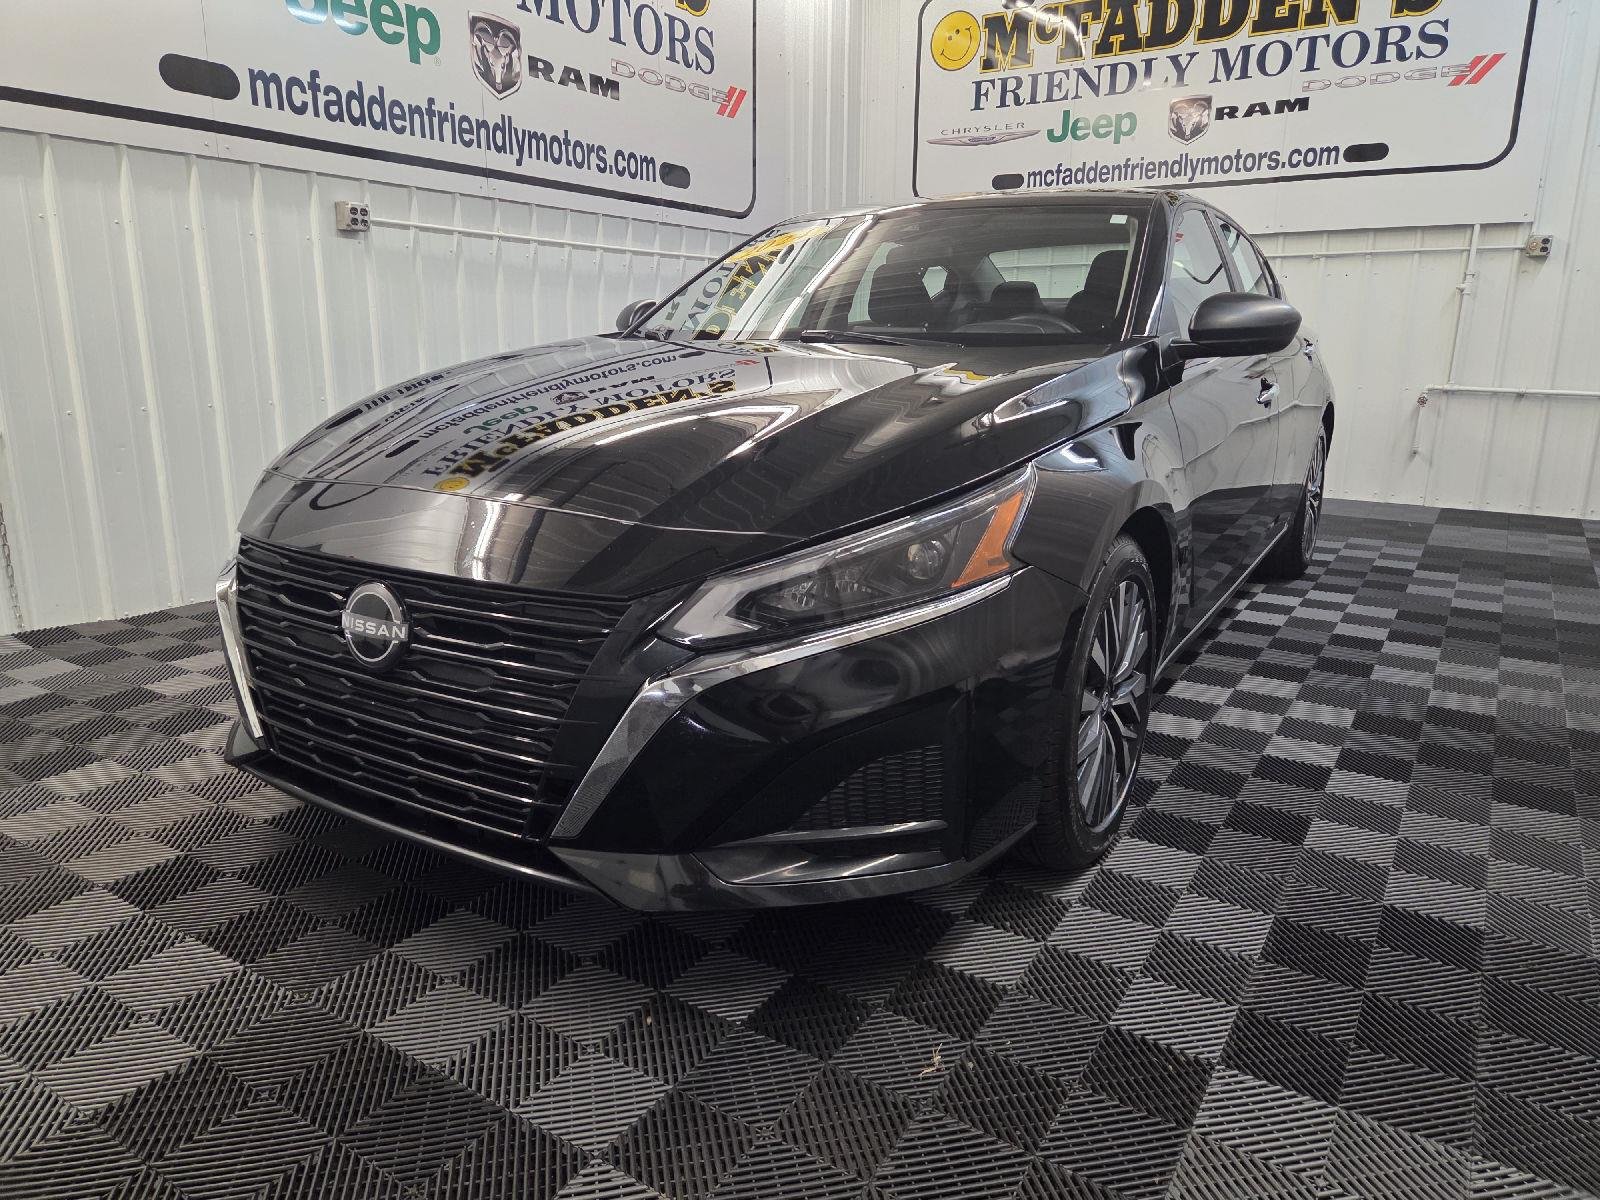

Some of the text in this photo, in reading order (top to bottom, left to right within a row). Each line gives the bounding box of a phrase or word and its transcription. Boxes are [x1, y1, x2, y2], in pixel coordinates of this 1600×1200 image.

[979, 0, 1441, 74] McFADDE
[527, 54, 620, 101] RAM
[610, 58, 730, 106] DODGE
[970, 18, 1449, 112] FRIENDLY MOTORS
[1302, 64, 1471, 93] DODGE
[248, 67, 657, 183] mcfaddenfriendlymotors.com
[940, 121, 1026, 136] CHRYSLER
[1046, 109, 1138, 145] Jeep
[1214, 96, 1311, 121] RAM
[1026, 144, 1340, 189] mcfaddenfriendlymotors.com
[342, 611, 406, 639] NISSAN
